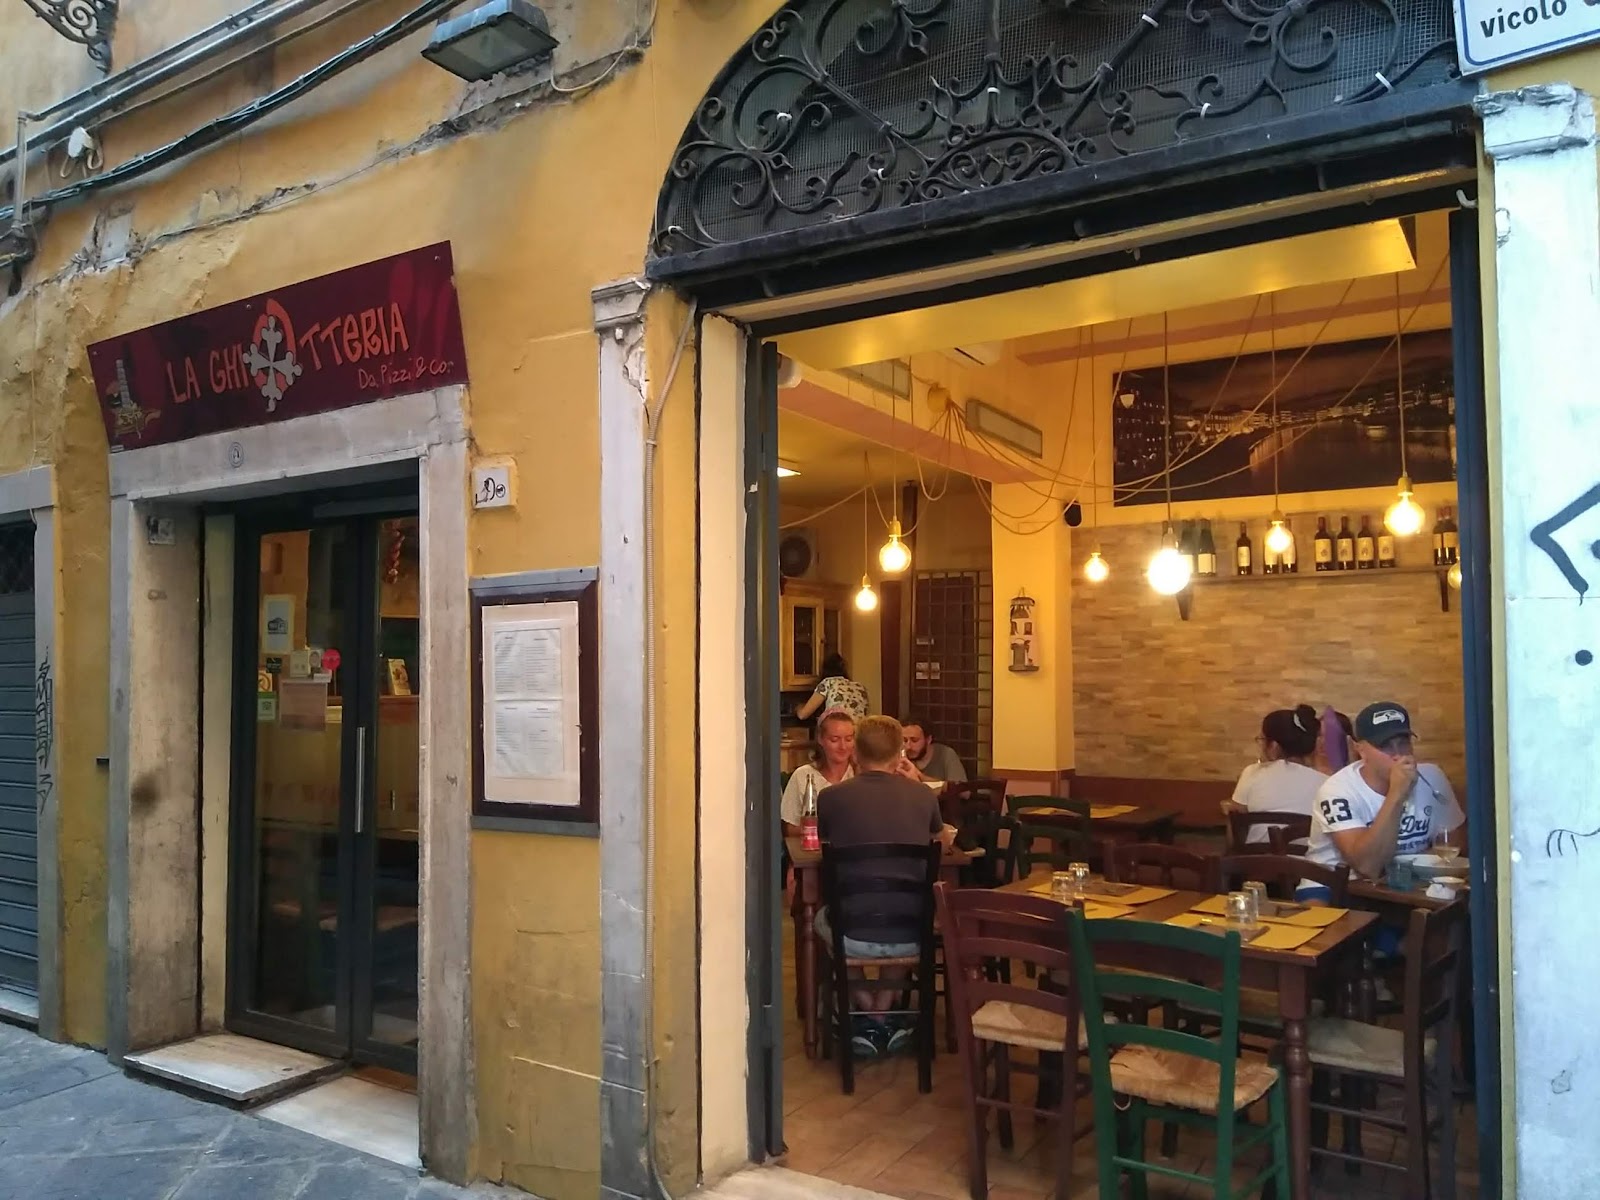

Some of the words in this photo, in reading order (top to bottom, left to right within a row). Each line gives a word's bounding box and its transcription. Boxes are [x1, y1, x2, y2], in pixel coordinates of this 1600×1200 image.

[1480, 0, 1567, 38] vicolo
[167, 357, 201, 404] LA
[415, 356, 427, 378] &
[1320, 798, 1352, 825] 23
